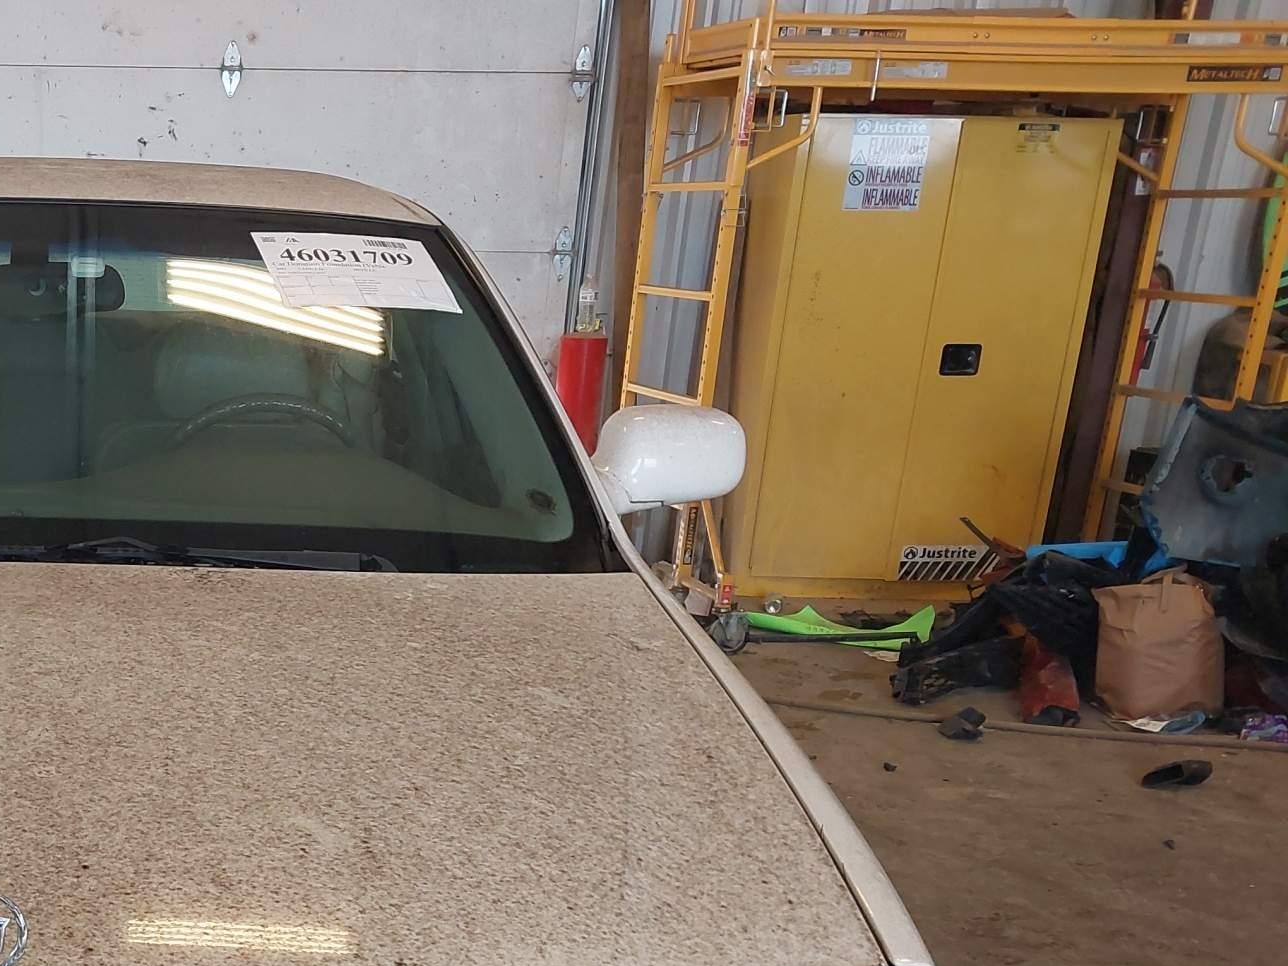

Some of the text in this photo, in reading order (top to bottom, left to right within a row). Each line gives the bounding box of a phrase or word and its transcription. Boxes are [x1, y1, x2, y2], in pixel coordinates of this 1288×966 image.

[872, 121, 927, 134] Justrite
[866, 166, 923, 183] INFLAMABLE
[862, 189, 920, 206] INFLAMMABLE
[280, 248, 412, 266] 46031709
[919, 547, 977, 559] Justrite
